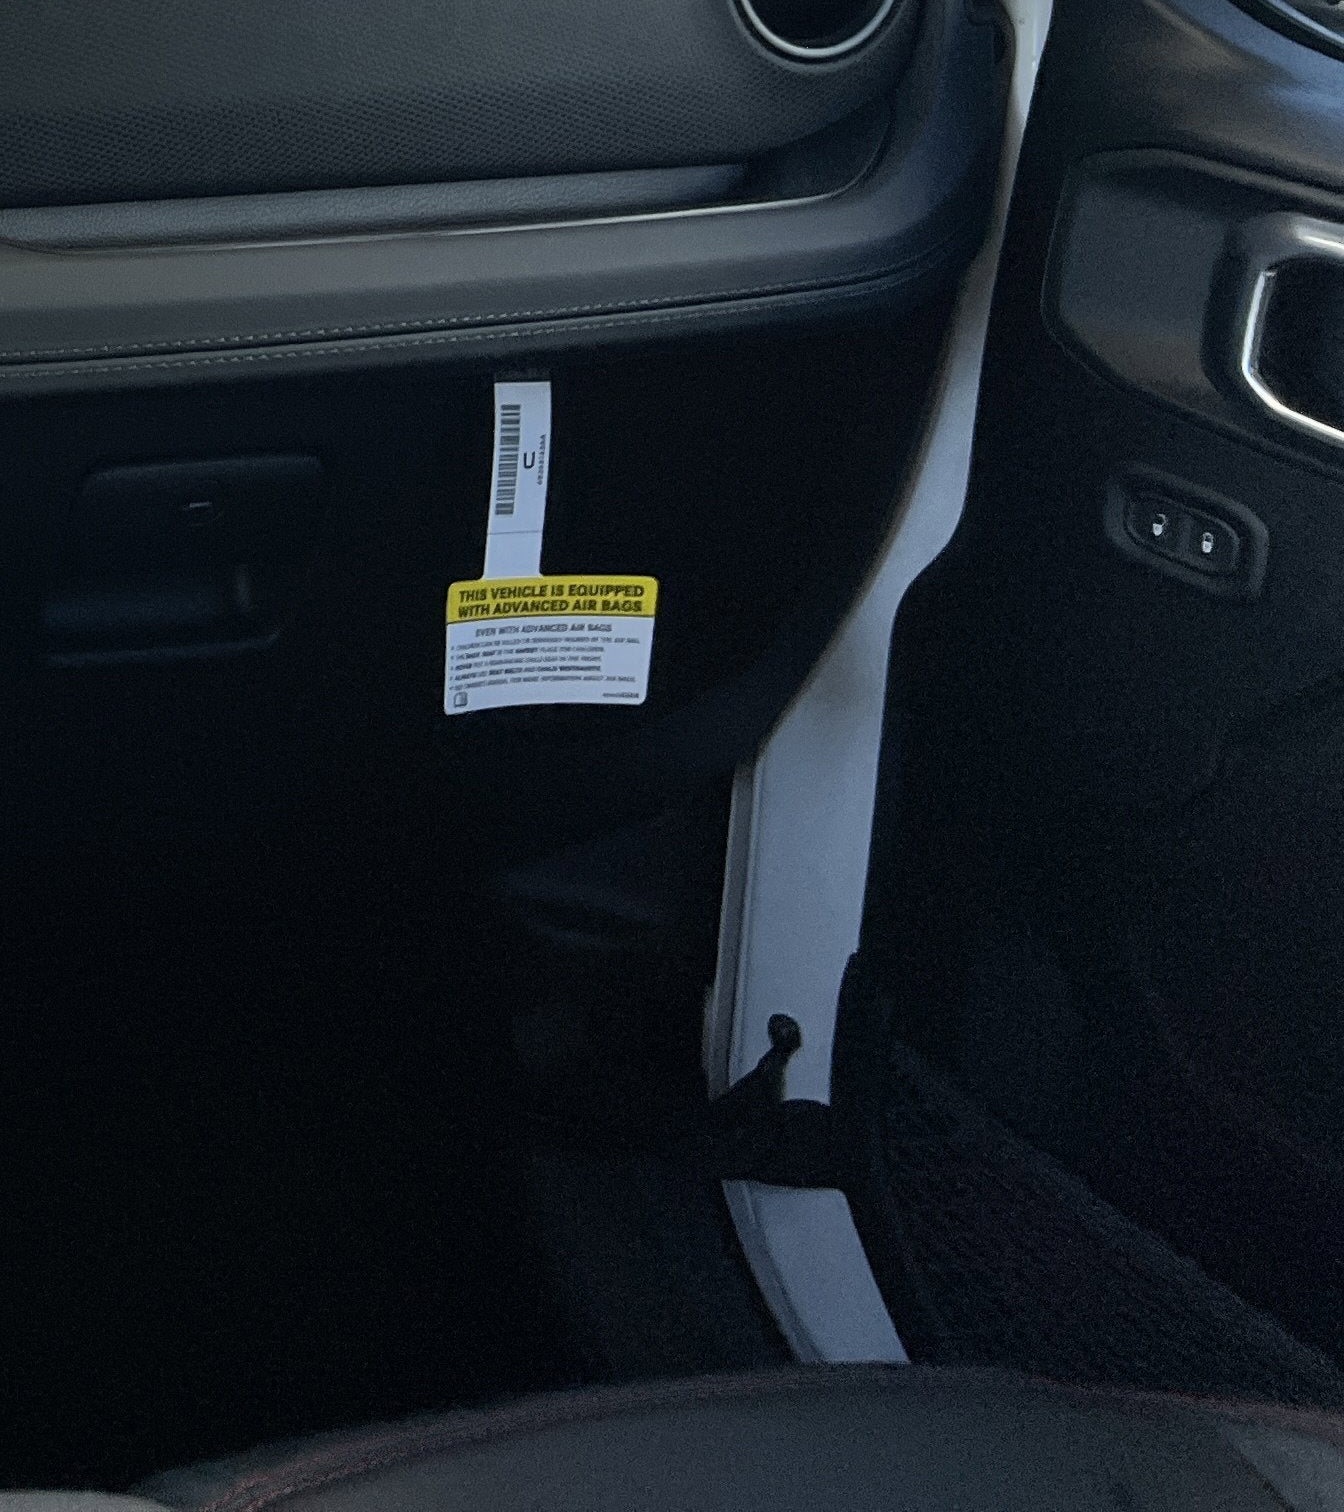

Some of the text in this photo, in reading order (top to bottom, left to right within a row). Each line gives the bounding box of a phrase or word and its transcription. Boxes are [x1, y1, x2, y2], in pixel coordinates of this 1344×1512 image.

[523, 451, 536, 469] U
[459, 583, 645, 603] THIS VEHICLE IS EQUIPPED
[457, 599, 642, 618] WITH ADVANCED AIR BAGS
